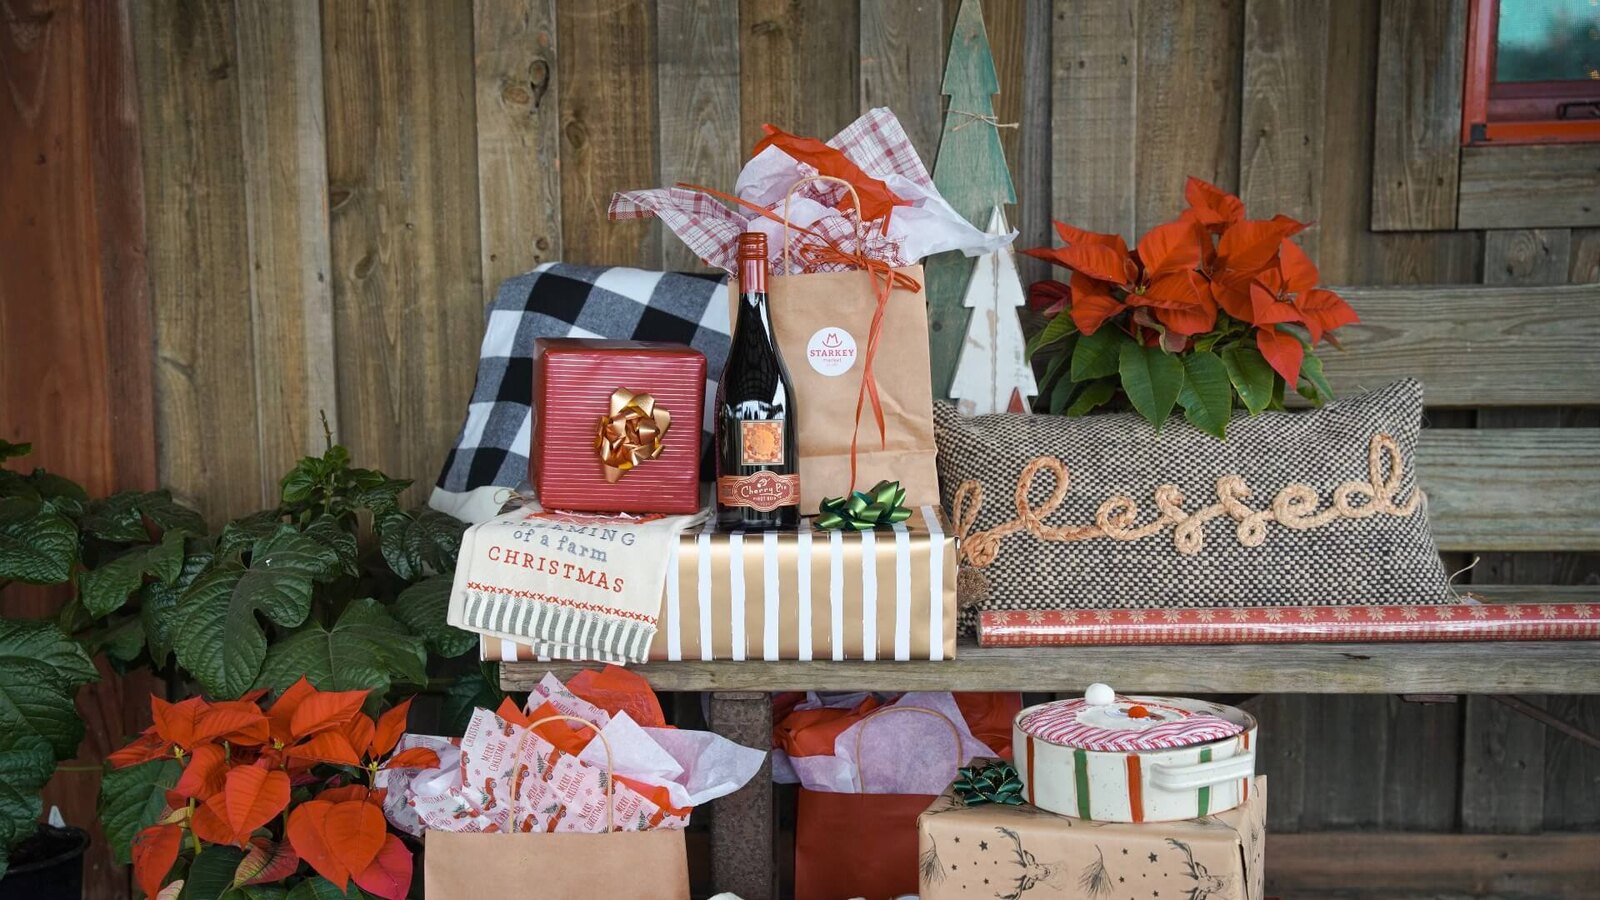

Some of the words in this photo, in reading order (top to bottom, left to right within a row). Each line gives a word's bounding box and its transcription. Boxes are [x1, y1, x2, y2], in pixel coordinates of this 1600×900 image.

[809, 349, 854, 357] STARKEY
[741, 485, 773, 498] Cherry
[513, 529, 536, 542] of
[539, 534, 550, 547] a
[557, 535, 607, 562] farm
[488, 546, 625, 593] CHRISTMAS
